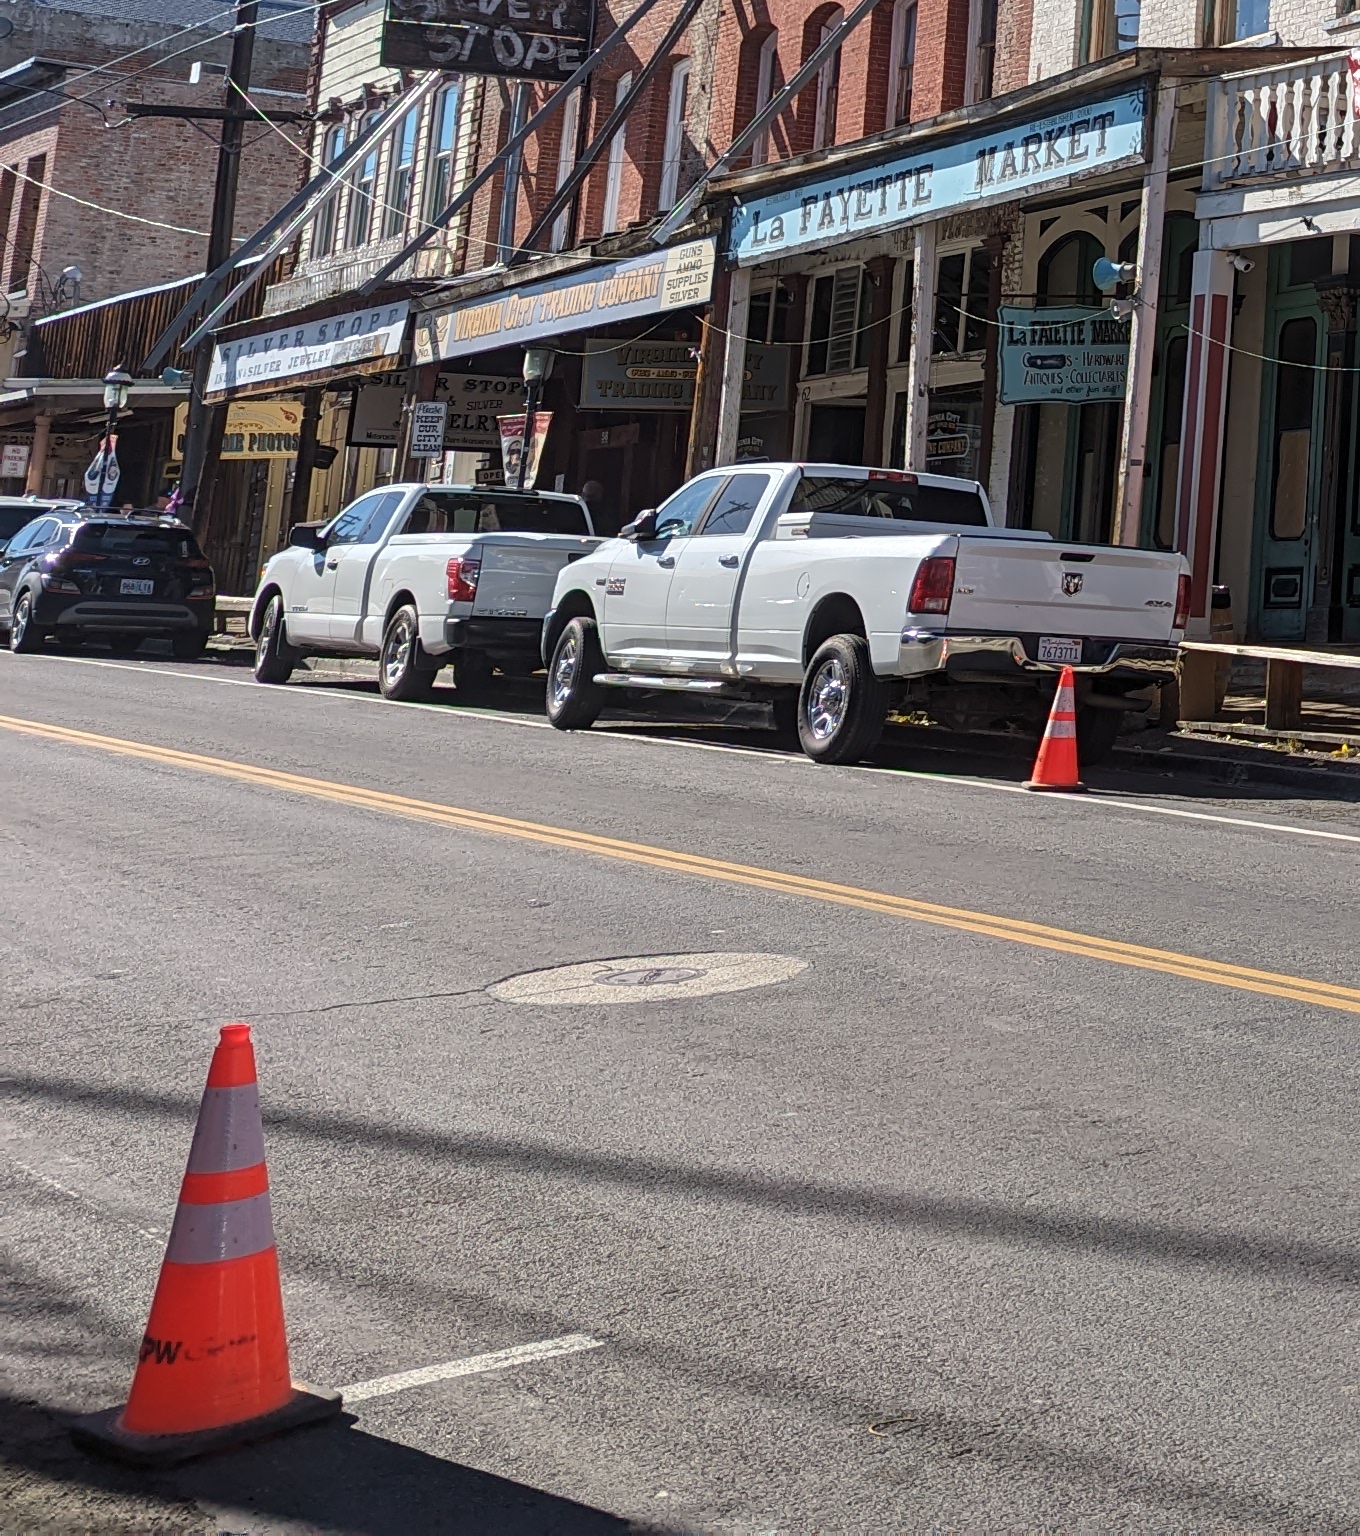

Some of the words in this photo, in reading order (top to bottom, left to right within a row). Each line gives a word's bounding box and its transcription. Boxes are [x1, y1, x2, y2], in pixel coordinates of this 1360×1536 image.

[424, 19, 582, 71] STOPE
[750, 210, 785, 248] La
[799, 163, 934, 234] FAYETTE
[974, 110, 1115, 191] MARKET
[680, 245, 702, 259] GUNS
[666, 271, 708, 291] SUPPLIES
[453, 301, 501, 342] VIRGINIA
[504, 293, 537, 328] CITY
[539, 281, 596, 322] TRADING
[598, 262, 665, 308] COMPANY
[669, 287, 700, 304] SILVER
[221, 330, 305, 365] SILVER
[317, 308, 399, 343] STOPE
[1091, 320, 1132, 346] MARKE
[248, 360, 281, 378] SILVER
[288, 348, 331, 369] JEWELRY
[1070, 368, 1125, 385] COLLECTABLES
[1050, 386, 1063, 394] and
[467, 400, 503, 411] SILVER
[416, 415, 443, 423] KEEP
[418, 425, 439, 433] OUR
[248, 432, 300, 452] PHOTOS
[417, 435, 441, 443] CITY
[1041, 645, 1079, 660] 76737T1
